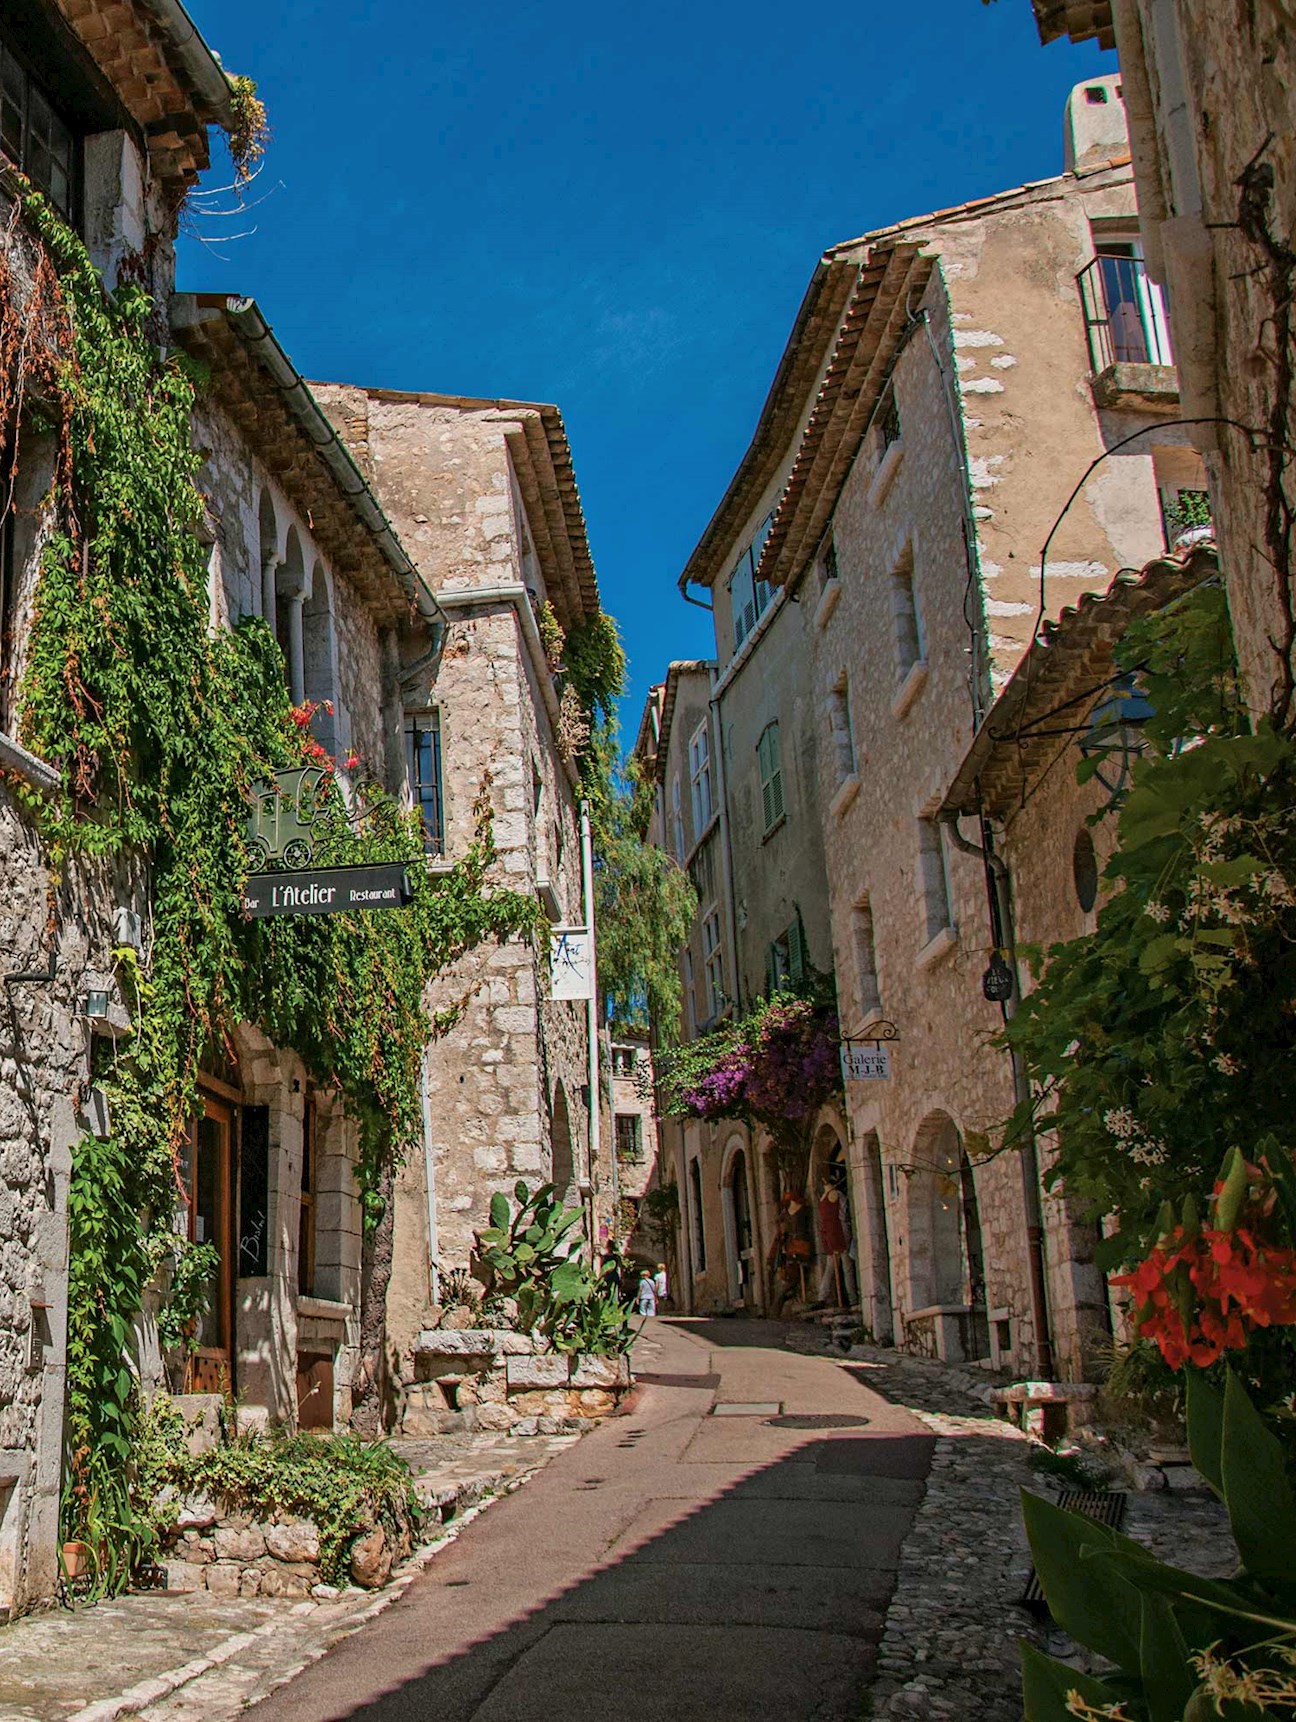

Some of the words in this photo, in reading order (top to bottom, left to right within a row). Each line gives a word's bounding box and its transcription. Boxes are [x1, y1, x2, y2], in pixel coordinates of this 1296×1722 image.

[244, 897, 260, 909] Bar
[272, 883, 336, 907] L'Atelier
[349, 888, 396, 902] Restaurant
[843, 1053, 887, 1065] Galerie
[848, 1065, 884, 1075] M-J-B
